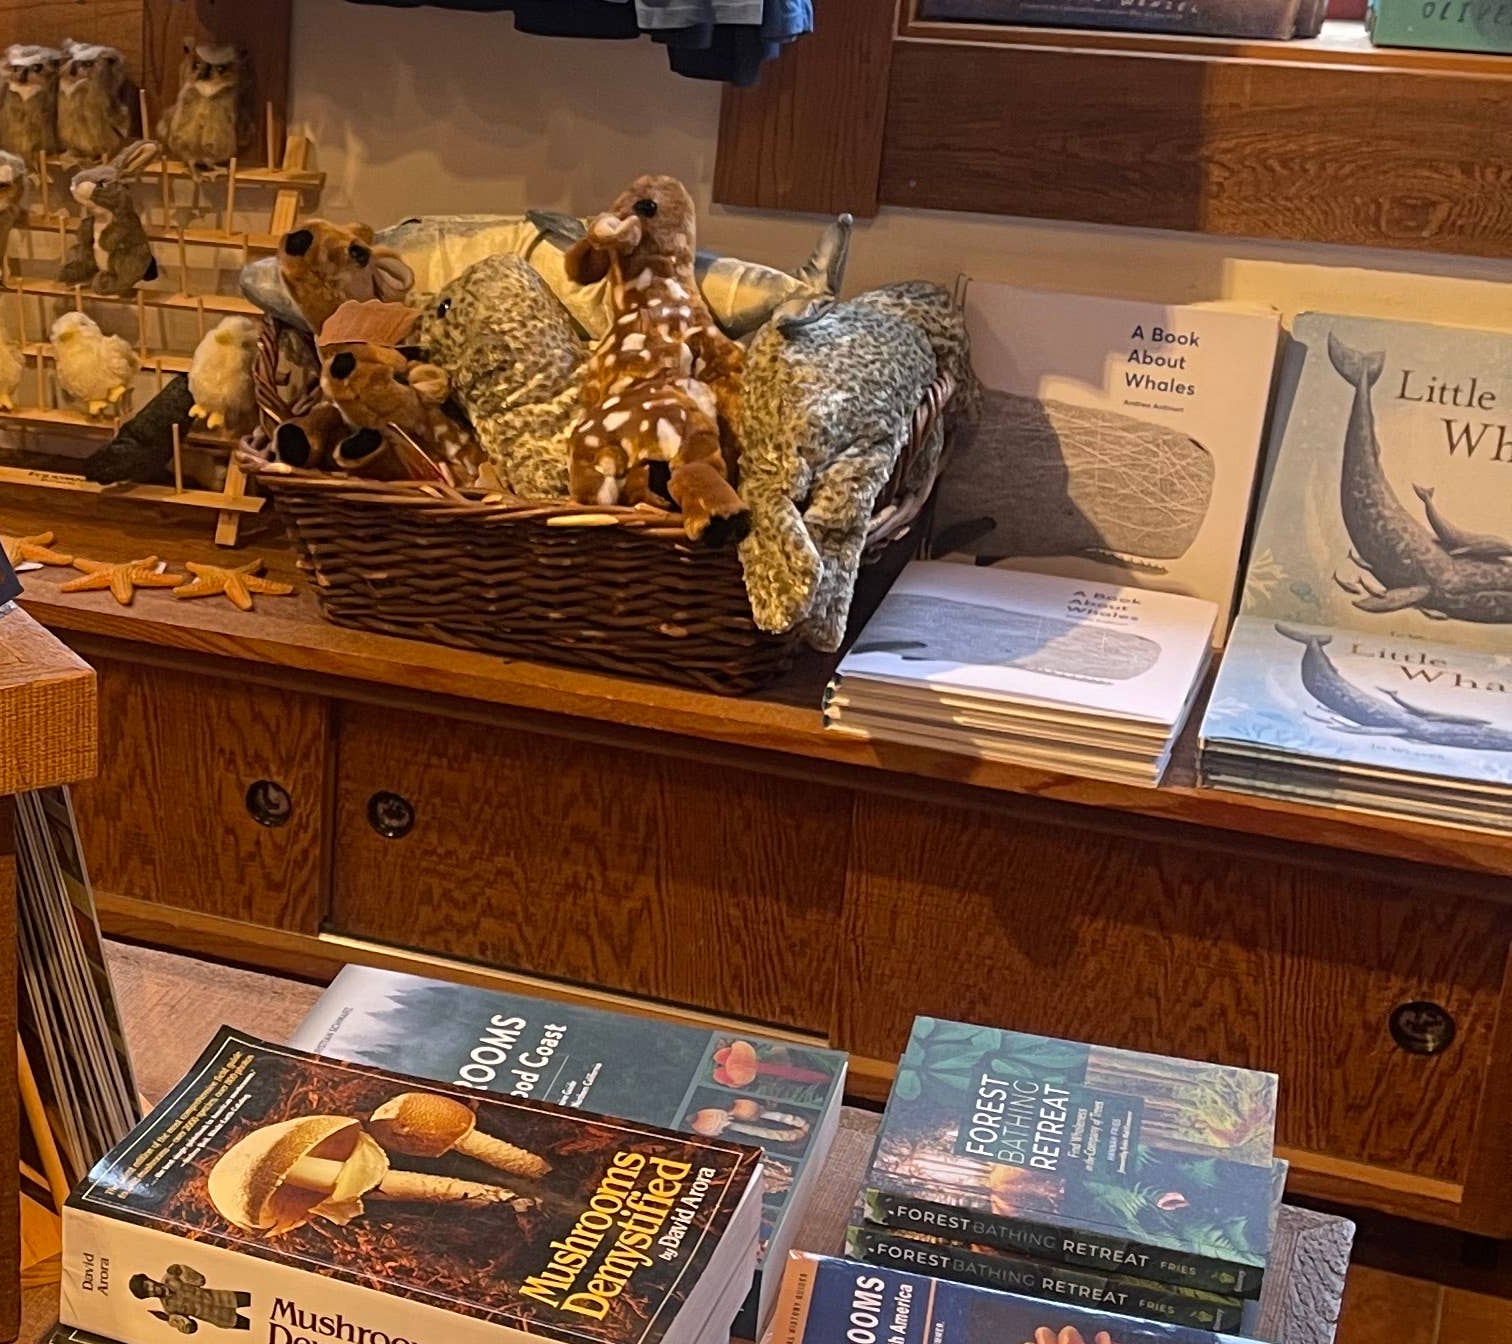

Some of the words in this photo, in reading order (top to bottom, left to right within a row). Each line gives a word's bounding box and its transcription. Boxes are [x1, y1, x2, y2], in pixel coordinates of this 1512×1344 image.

[1131, 325, 1144, 340] A
[1151, 326, 1200, 348] Book
[1127, 349, 1186, 370] About
[1125, 372, 1196, 396] Whales
[1396, 370, 1496, 410] Little
[965, 1073, 1010, 1157] FOREST
[997, 1080, 1039, 1165] BATHING
[1029, 1083, 1071, 1171] RETREAT
[680, 1166, 716, 1209] Arora
[519, 1151, 646, 1308] Mushrooms
[560, 1156, 692, 1321] Demystified
[658, 1205, 694, 1249] David
[658, 1248, 678, 1261] by
